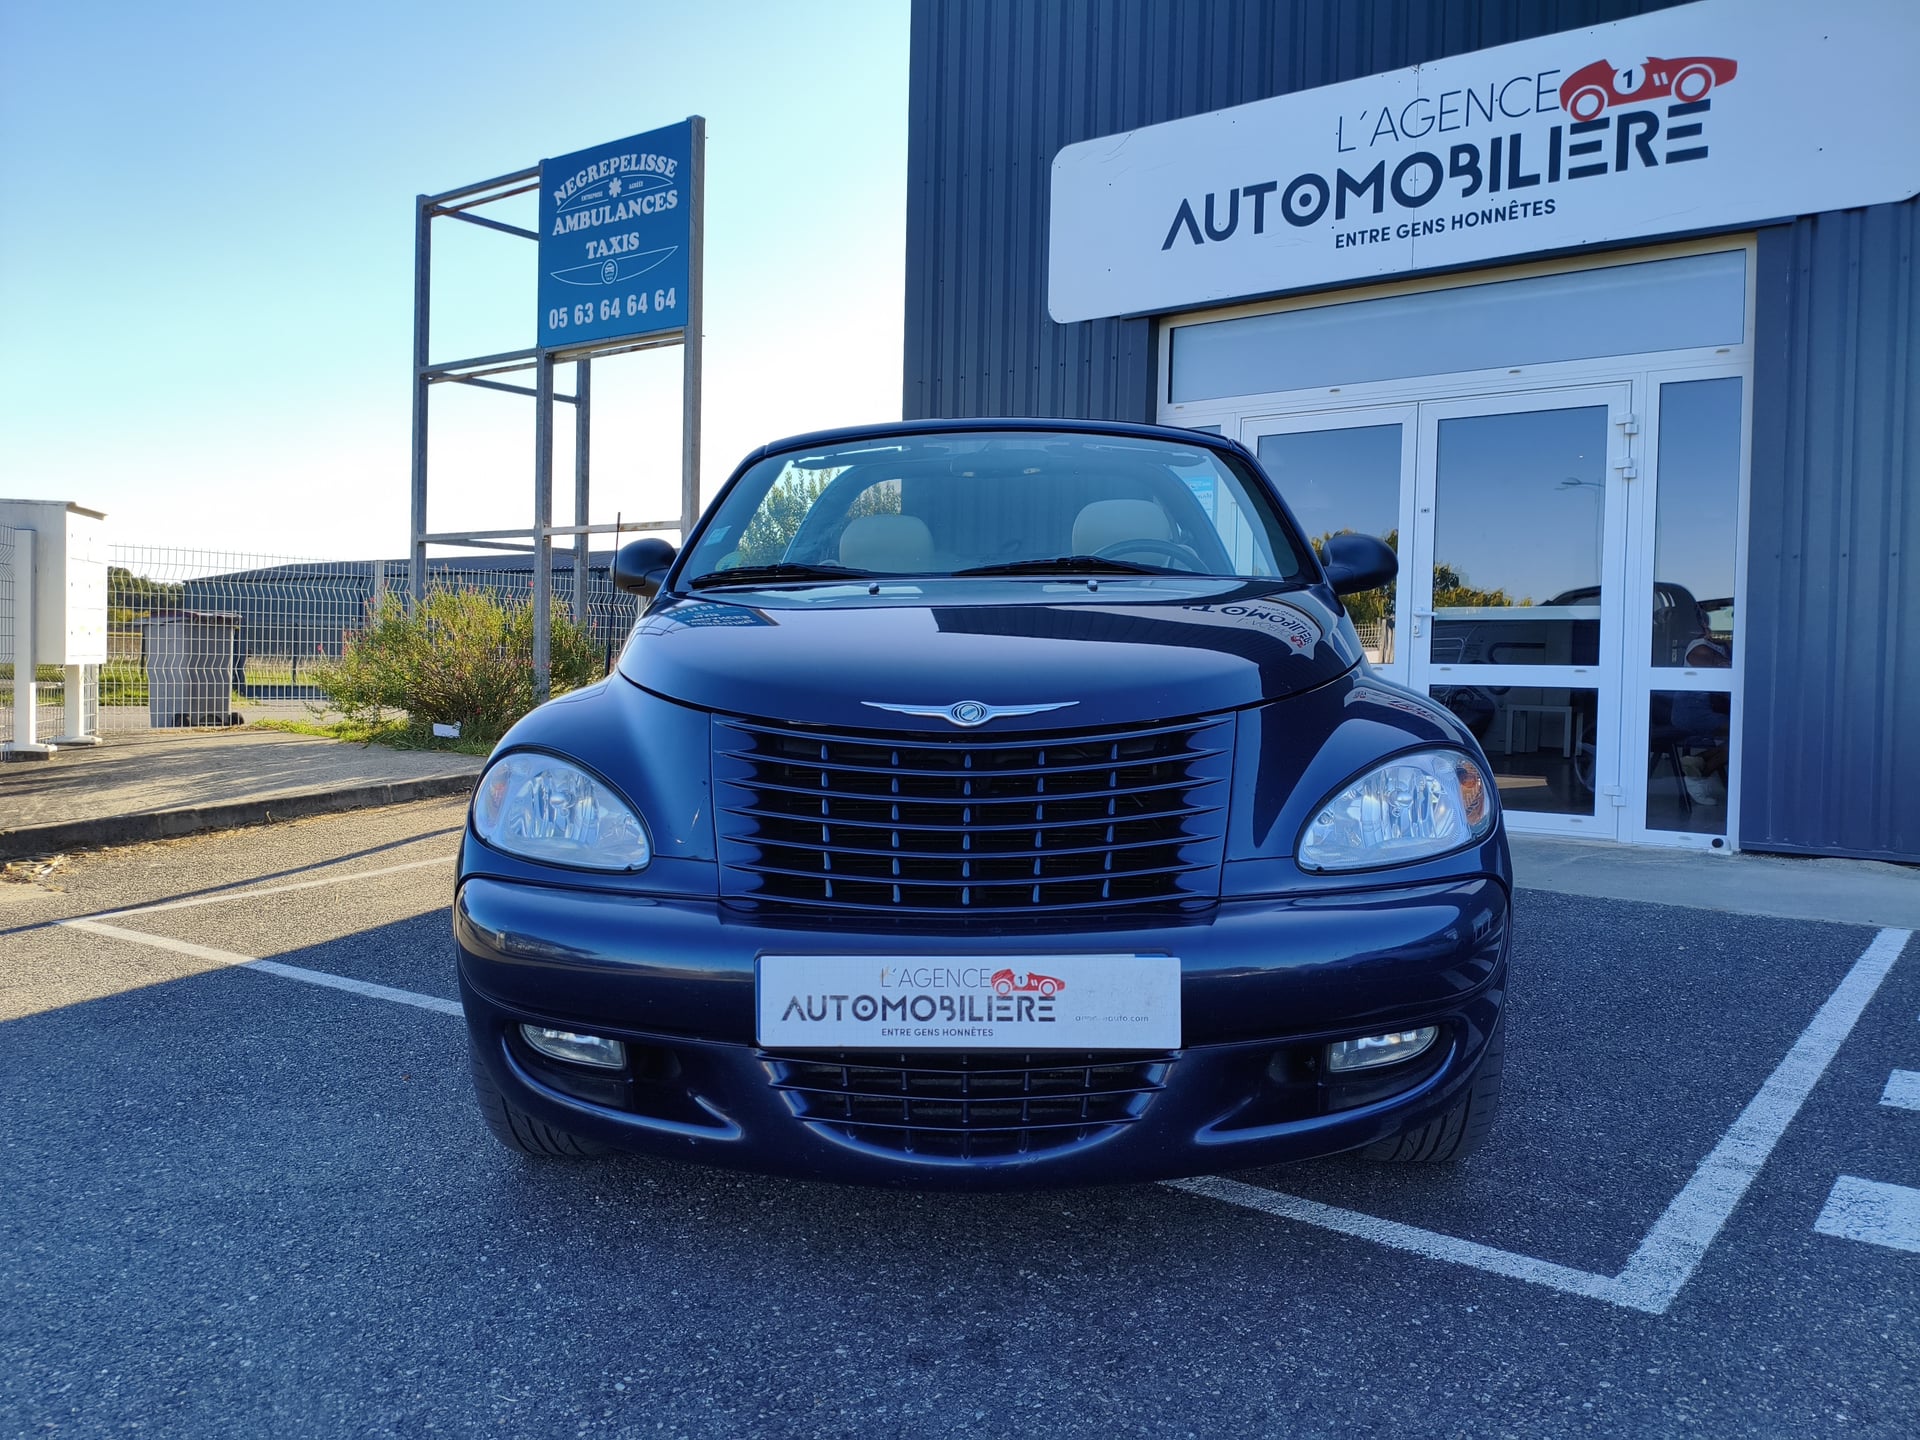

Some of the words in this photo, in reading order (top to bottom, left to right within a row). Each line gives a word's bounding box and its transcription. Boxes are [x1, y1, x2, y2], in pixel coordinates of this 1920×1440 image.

[1622, 69, 1633, 88] 1
[1337, 69, 1561, 152] L'AGENCE
[553, 153, 678, 206] NEGREPELISSE
[552, 189, 678, 236] AMBULANCES
[1335, 226, 1391, 249] ENTRE
[1396, 217, 1446, 239] GENS
[1451, 198, 1556, 231] HONNÊTES
[585, 231, 640, 260] TAXIS
[549, 307, 568, 330] 05
[574, 302, 594, 325] 63
[600, 297, 621, 321] 64
[627, 292, 648, 317] 64
[654, 287, 676, 312] 64
[881, 1027, 911, 1037] ENTRE
[914, 1027, 940, 1037] GENS
[942, 1025, 994, 1037] HONNÊTES
